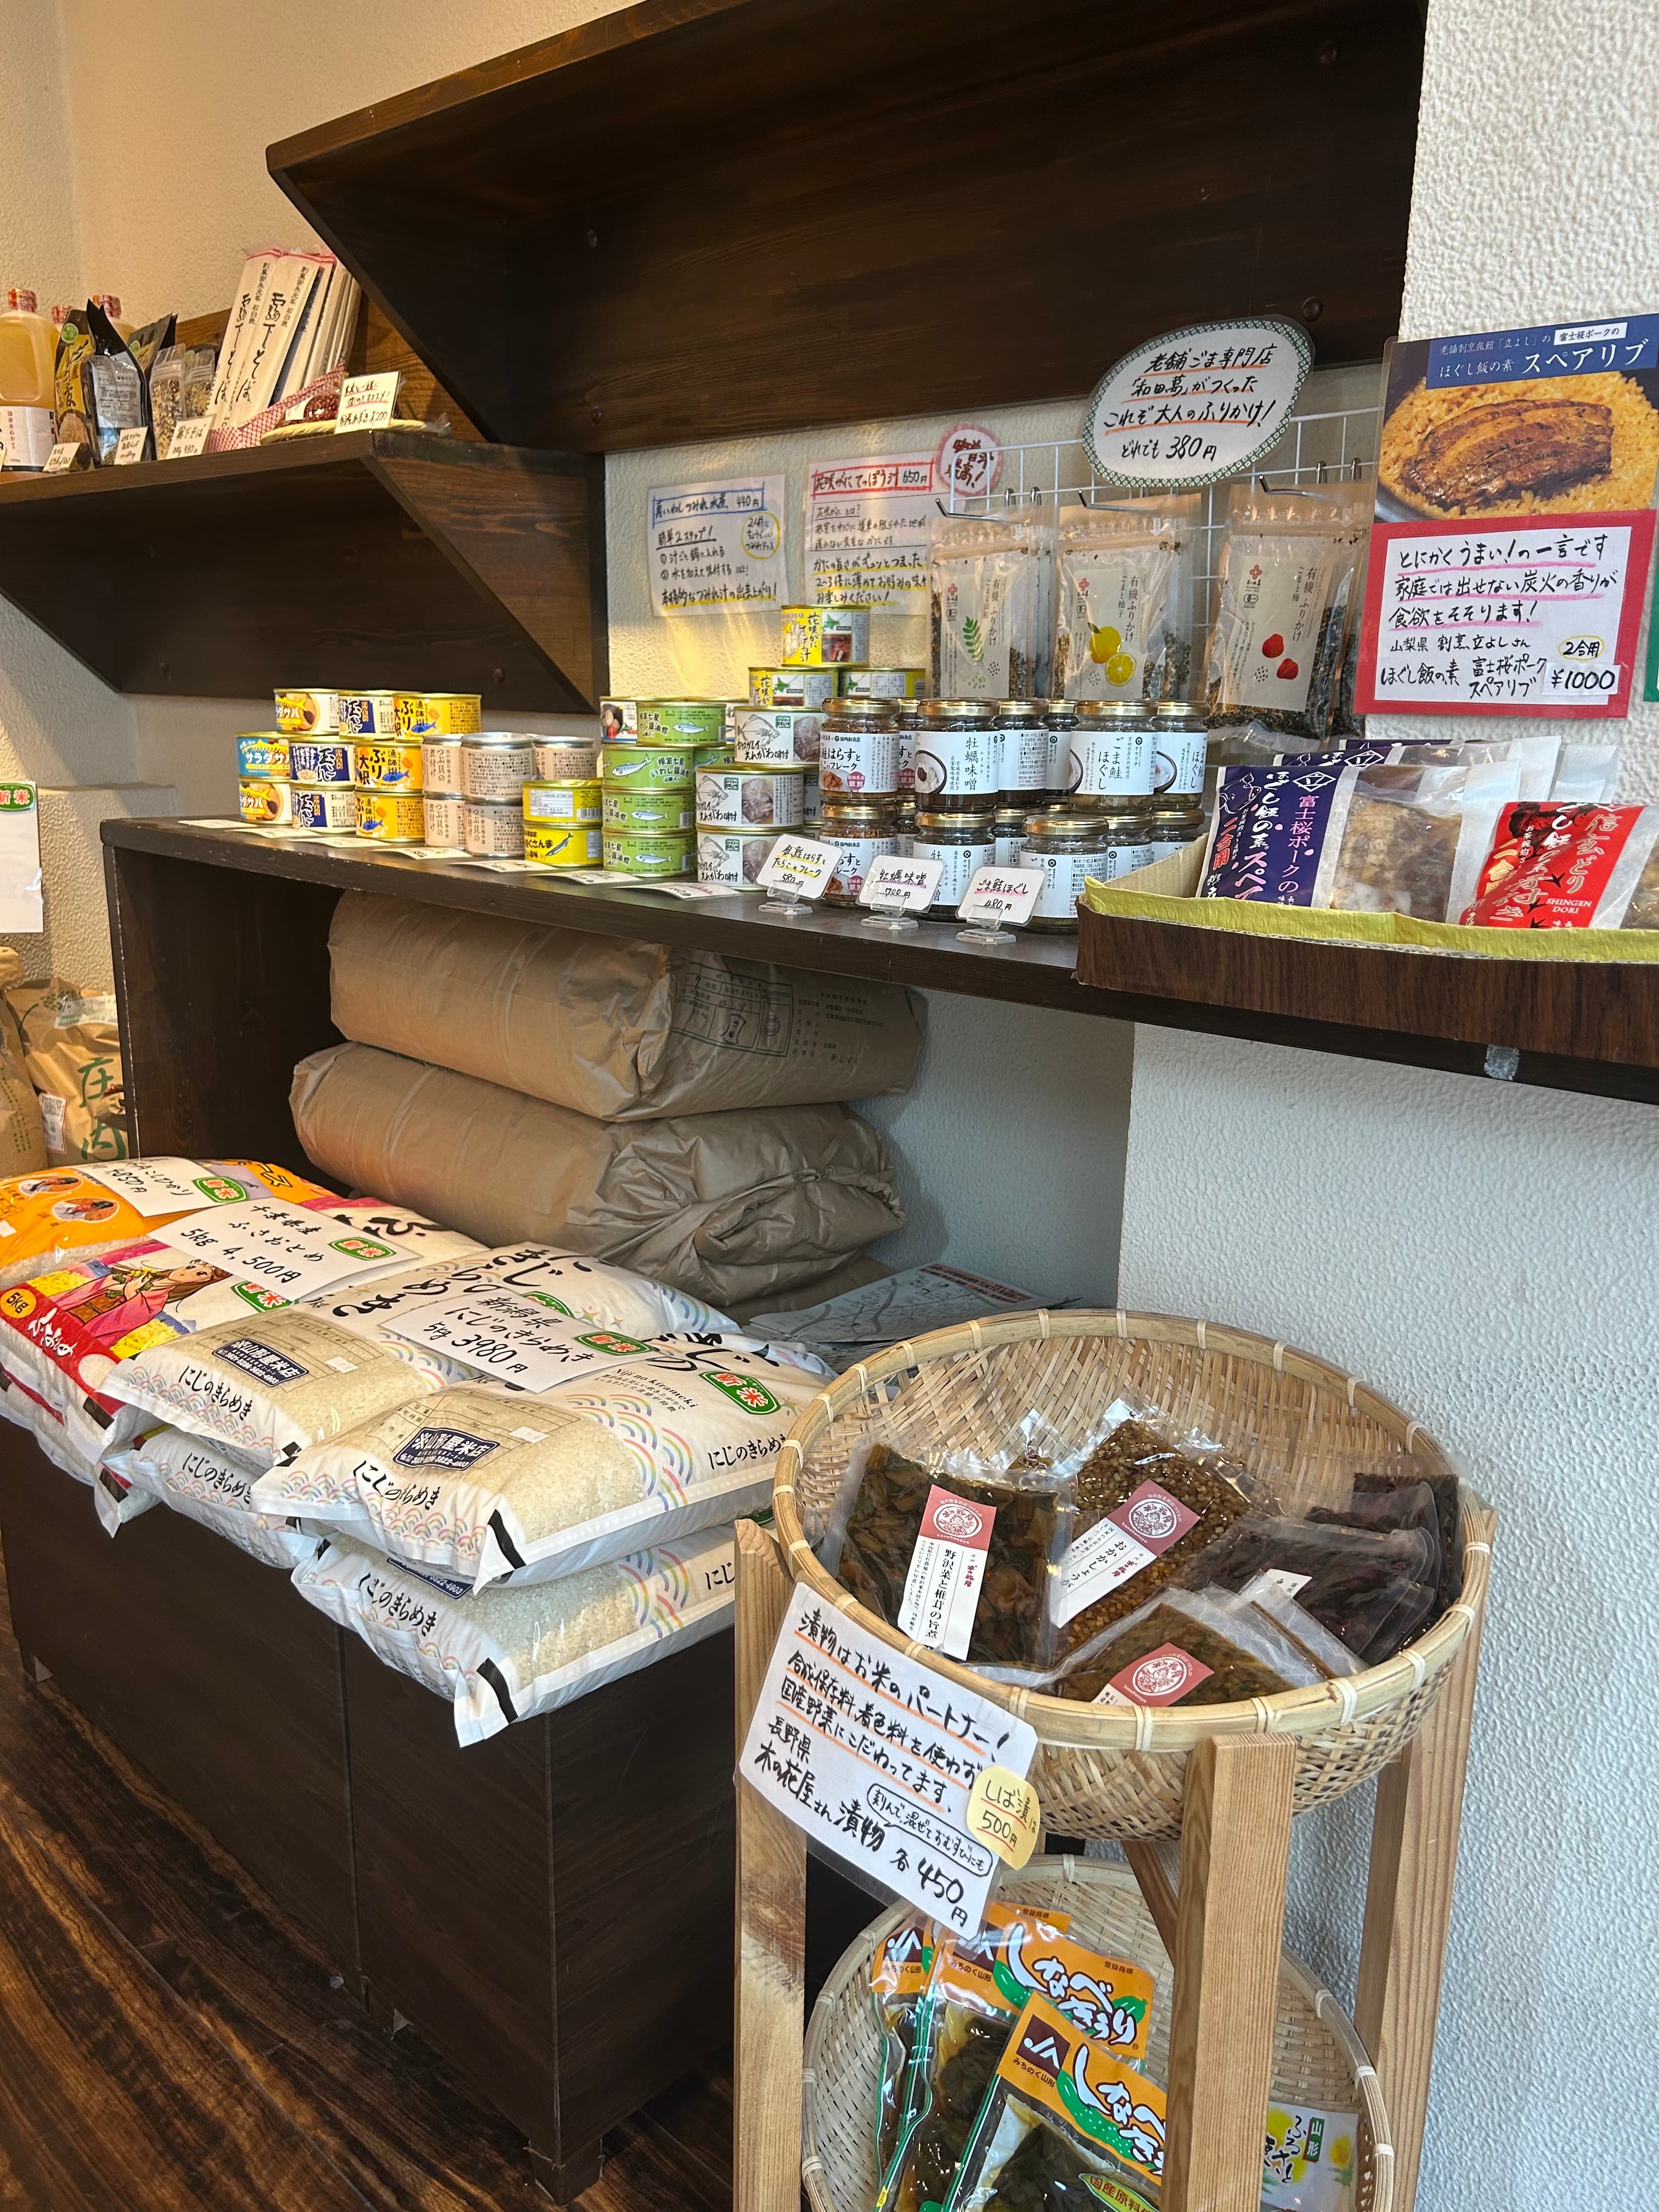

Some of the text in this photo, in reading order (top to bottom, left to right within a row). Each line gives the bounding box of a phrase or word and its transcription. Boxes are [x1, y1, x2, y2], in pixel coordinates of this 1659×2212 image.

[1559, 327, 1620, 342] 富士桜ポークの
[1144, 343, 1278, 374] 老舗ごま専門店
[1439, 358, 1516, 379] ほぐし飯の素
[1521, 338, 1649, 375] スペアリブ
[1103, 399, 1276, 428] これぞ大人のふりかけ!
[176, 424, 207, 439] 霧下そば
[1121, 435, 1217, 462] どれでも 380円
[902, 470, 928, 485] 650円
[736, 495, 759, 508] 440円
[1394, 568, 1619, 602] 家庭では出せない炭火の香りが
[1125, 575, 1139, 642] 有機ふりかけ
[1292, 567, 1318, 642] 有機ふりかけ
[1389, 600, 1538, 629] 食欲をそそります!
[1390, 636, 1429, 653] 山梨県
[1562, 639, 1601, 658] 2合用
[1381, 654, 1616, 690] ほぐし飯の素 富士桜ポーク ¥1000
[1469, 676, 1537, 699] スペアリブ
[402, 700, 415, 731] ぶり
[369, 748, 386, 779] ぶり
[436, 748, 445, 782] つぶ貝の
[657, 755, 686, 766] 根室七星
[744, 748, 790, 760] えんがわ味付
[964, 737, 978, 791] 牡蠣味噌
[1109, 736, 1124, 780] ごま鮭
[359, 754, 371, 786] 大根
[1098, 751, 1109, 791] ほぐし
[1189, 751, 1200, 789] ほぐし
[435, 803, 444, 837] つぶ貝の
[699, 807, 738, 822] えんがわ味付
[1248, 770, 1290, 849] ほぐし飯の素
[1213, 816, 1238, 871] 二合用
[1277, 794, 1322, 893] 富士桜ポークの
[1566, 814, 1624, 894] 信玄どり
[771, 856, 822, 879] たらこのフレーク
[975, 878, 1030, 895] ごま鮭ほぐし
[1547, 898, 1592, 907] SHINGEN
[1551, 906, 1579, 914] DORI
[204, 1178, 240, 1200] 新米
[249, 1205, 324, 1236] 千葉県産
[180, 1228, 303, 1284] 5kg 4,500円
[229, 1221, 325, 1262] ふさおとめ
[340, 1239, 388, 1259] 新米
[7, 1291, 30, 1315] 5kg
[476, 1296, 563, 1330] 新潟県
[423, 1321, 529, 1375] 5kg 3980円
[444, 1306, 596, 1364] にじのきらめき
[588, 1333, 640, 1355] 新米
[239, 1342, 301, 1378] 山形屋米店
[178, 1364, 253, 1421] にじのきらめき
[648, 1378, 699, 1408] kirameki
[712, 1372, 770, 1409] 新米
[425, 1432, 490, 1457] 山形屋米店
[925, 1548, 957, 1640] 野沢菜と椎茸の旨煮
[798, 1606, 1011, 1763] 漬物はお米のパートナー!
[768, 1715, 813, 1765] 長野県
[983, 1779, 1032, 1823] しば漬
[980, 1809, 1018, 1848] 500円
[832, 1798, 887, 1854] 漬物
[889, 1848, 911, 1872] 各
[917, 1856, 969, 1928] 450円
[1022, 1907, 1050, 1920] 登録商標
[882, 1962, 922, 1975] みちのく山形
[950, 1959, 993, 1983] みちのく山形
[1104, 1960, 1135, 1976] 登録商標
[1013, 2056, 1057, 2088] みちのく山形
[1307, 2120, 1323, 2157] 山形
